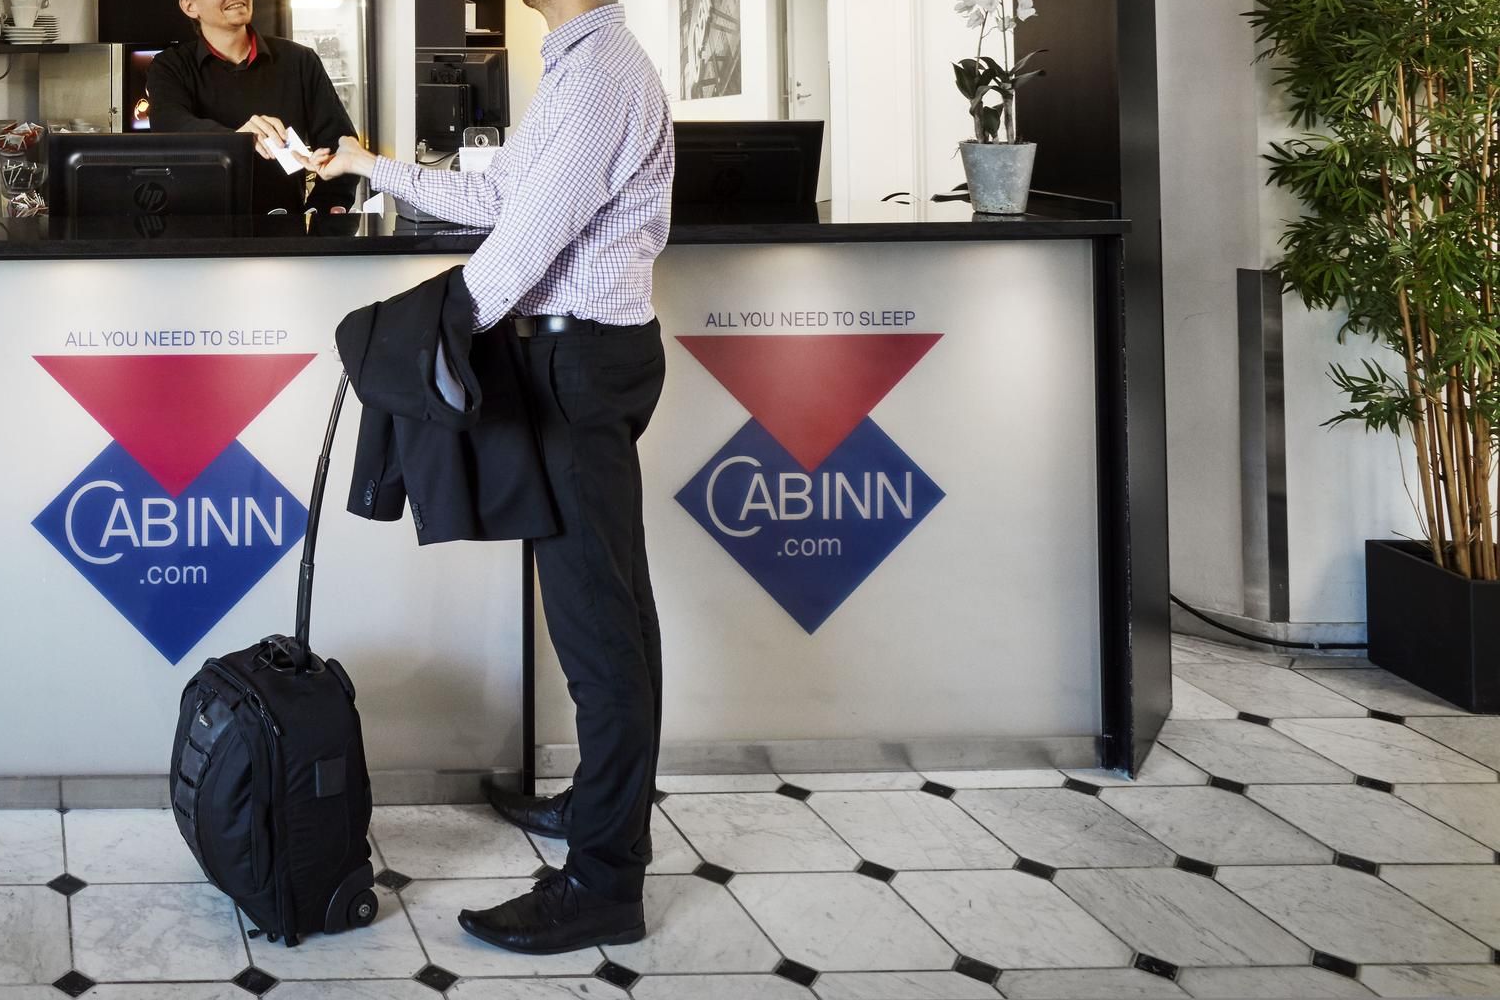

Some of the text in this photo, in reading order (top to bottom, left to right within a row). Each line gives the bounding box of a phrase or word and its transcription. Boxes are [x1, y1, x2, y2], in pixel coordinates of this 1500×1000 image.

[138, 182, 166, 212] hp
[705, 310, 916, 328] ALL YOU NEED TO SLEEP
[64, 330, 288, 347] ALL YOU NEED TO SLEEP
[705, 455, 913, 538] CABINN
[64, 480, 283, 565] CABINN
[776, 537, 842, 556] .com
[139, 565, 208, 585] .com
